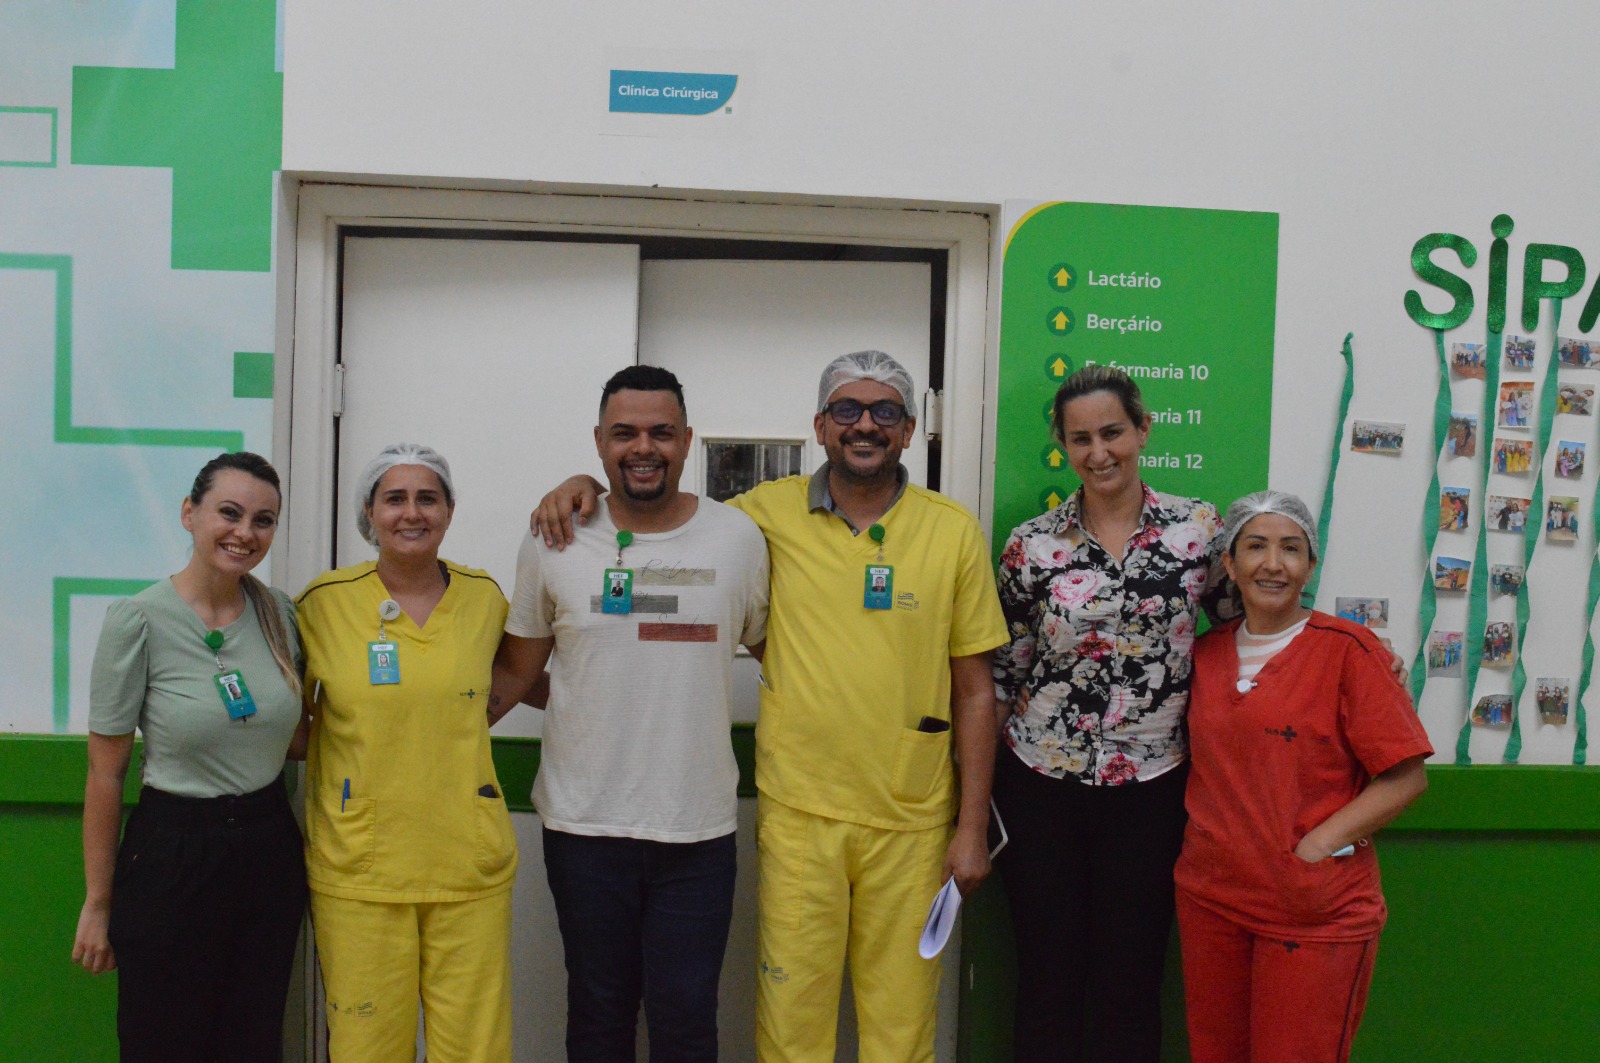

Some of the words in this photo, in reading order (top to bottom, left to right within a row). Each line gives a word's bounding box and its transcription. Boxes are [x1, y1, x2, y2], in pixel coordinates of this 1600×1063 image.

[618, 85, 659, 97] Clínica
[662, 86, 719, 100] Cirúrgica
[1088, 270, 1161, 289] Lactário
[1086, 313, 1162, 334] Berçário
[1188, 364, 1209, 381] 10
[1186, 409, 1202, 425] 11
[1184, 453, 1203, 469] 12
